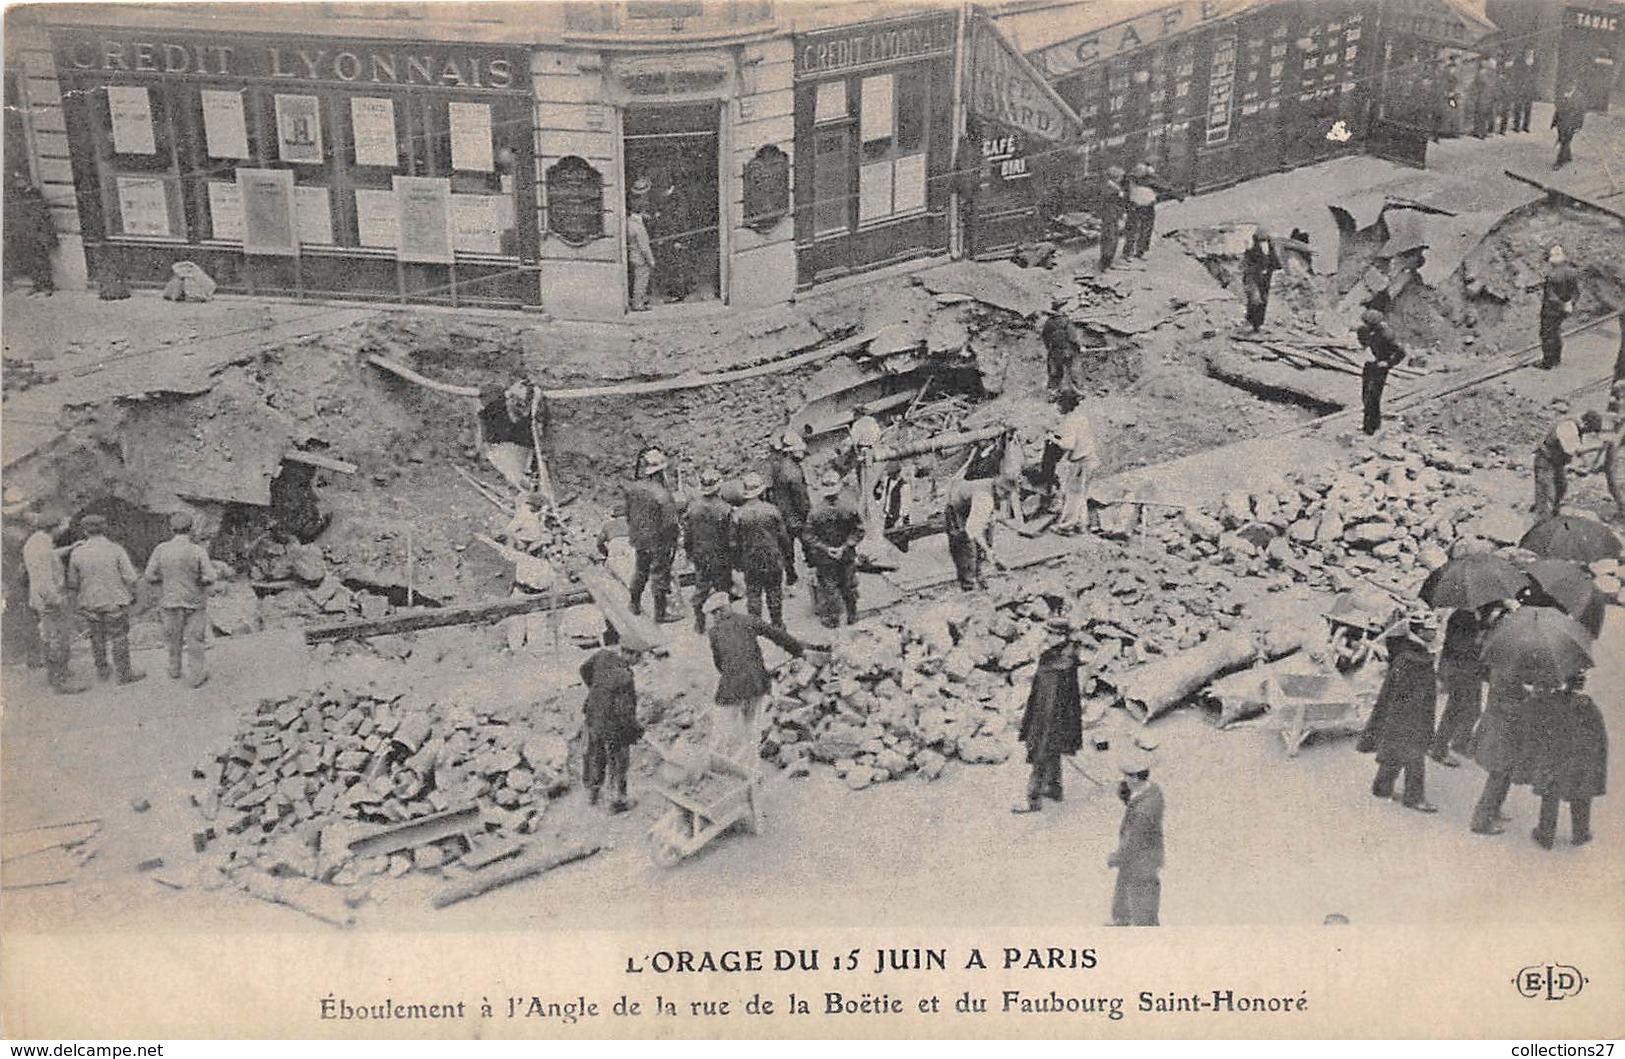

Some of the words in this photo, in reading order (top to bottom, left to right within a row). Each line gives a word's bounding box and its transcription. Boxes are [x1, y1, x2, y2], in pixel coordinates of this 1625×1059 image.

[1577, 12, 1618, 31] TABAC
[69, 39, 235, 76] CREDIT
[268, 47, 514, 90] LYONNAIS
[803, 37, 867, 72] CREDIT
[983, 134, 1015, 155] CAFÉ
[626, 949, 763, 973] L'ORAGE
[774, 949, 820, 971] DU
[834, 948, 861, 971] 15
[874, 948, 947, 974] JUIN
[965, 948, 987, 970] A
[1004, 947, 1097, 969] PARIS
[321, 992, 466, 1020] Éboulement
[481, 996, 493, 1018] à
[508, 996, 599, 1024] l'Angle
[613, 995, 641, 1017] de
[656, 995, 677, 1017] la
[691, 1001, 731, 1016] rue
[746, 993, 775, 1016] de
[789, 993, 811, 1015] la
[825, 992, 904, 1015] Boëtie
[918, 995, 940, 1014] et
[956, 991, 987, 1014] du
[1002, 990, 1124, 1021] Faubourg
[1139, 989, 1308, 1012] Saint-Honoré
